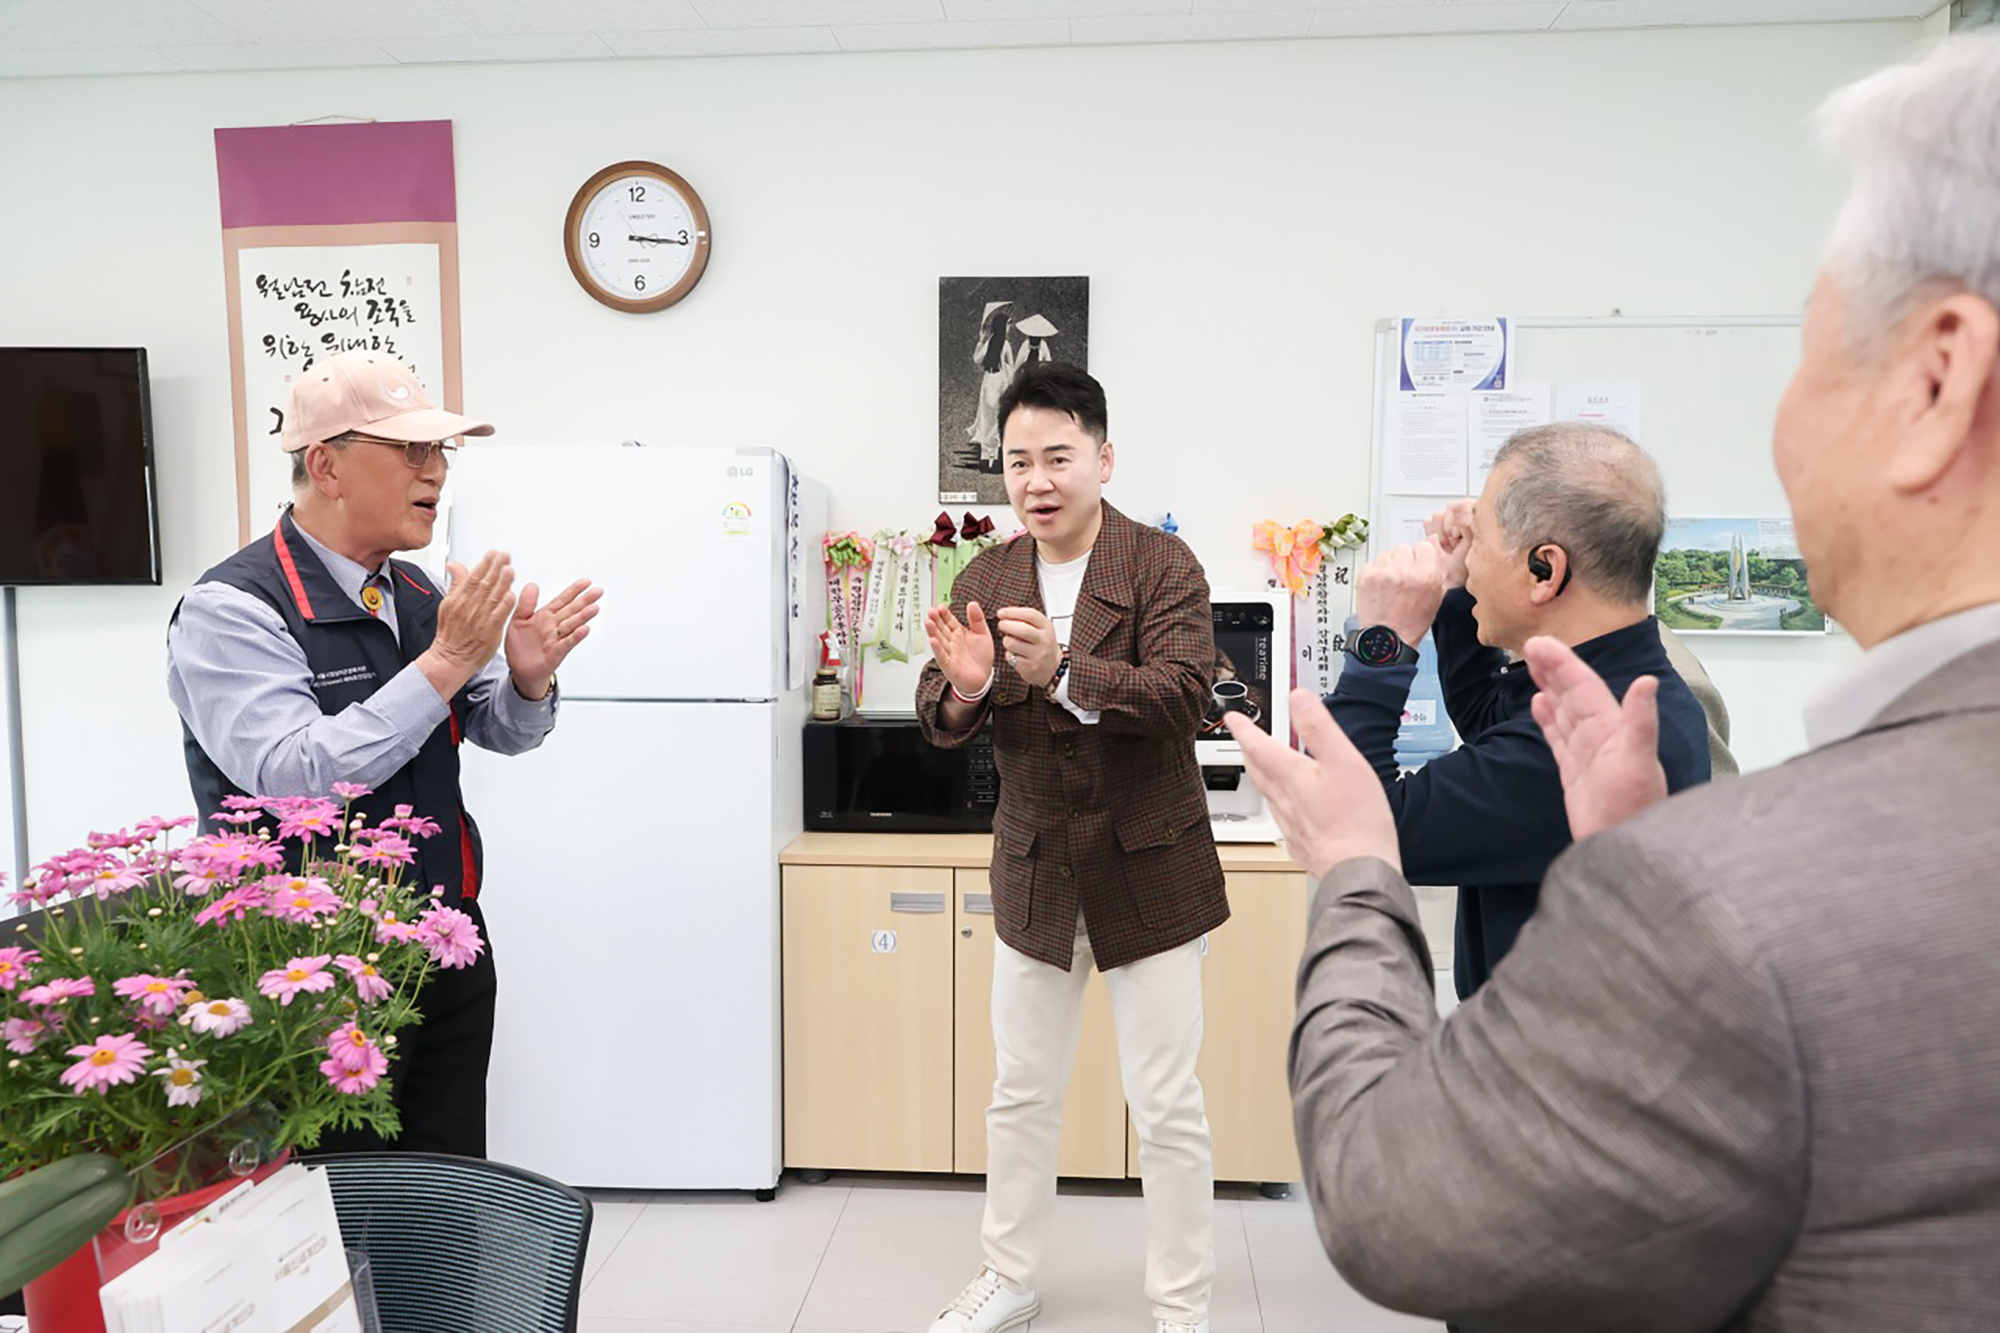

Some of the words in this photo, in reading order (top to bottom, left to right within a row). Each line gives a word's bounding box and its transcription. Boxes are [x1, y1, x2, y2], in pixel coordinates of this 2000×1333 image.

[628, 186, 646, 203] 12
[588, 232, 600, 249] 9
[677, 229, 689, 246] 3
[256, 274, 333, 300] 월남전
[340, 269, 388, 298] 참전
[634, 274, 646, 291] 6
[366, 298, 417, 328] 조국을
[740, 467, 754, 476] LG
[871, 930, 897, 951] (4)
